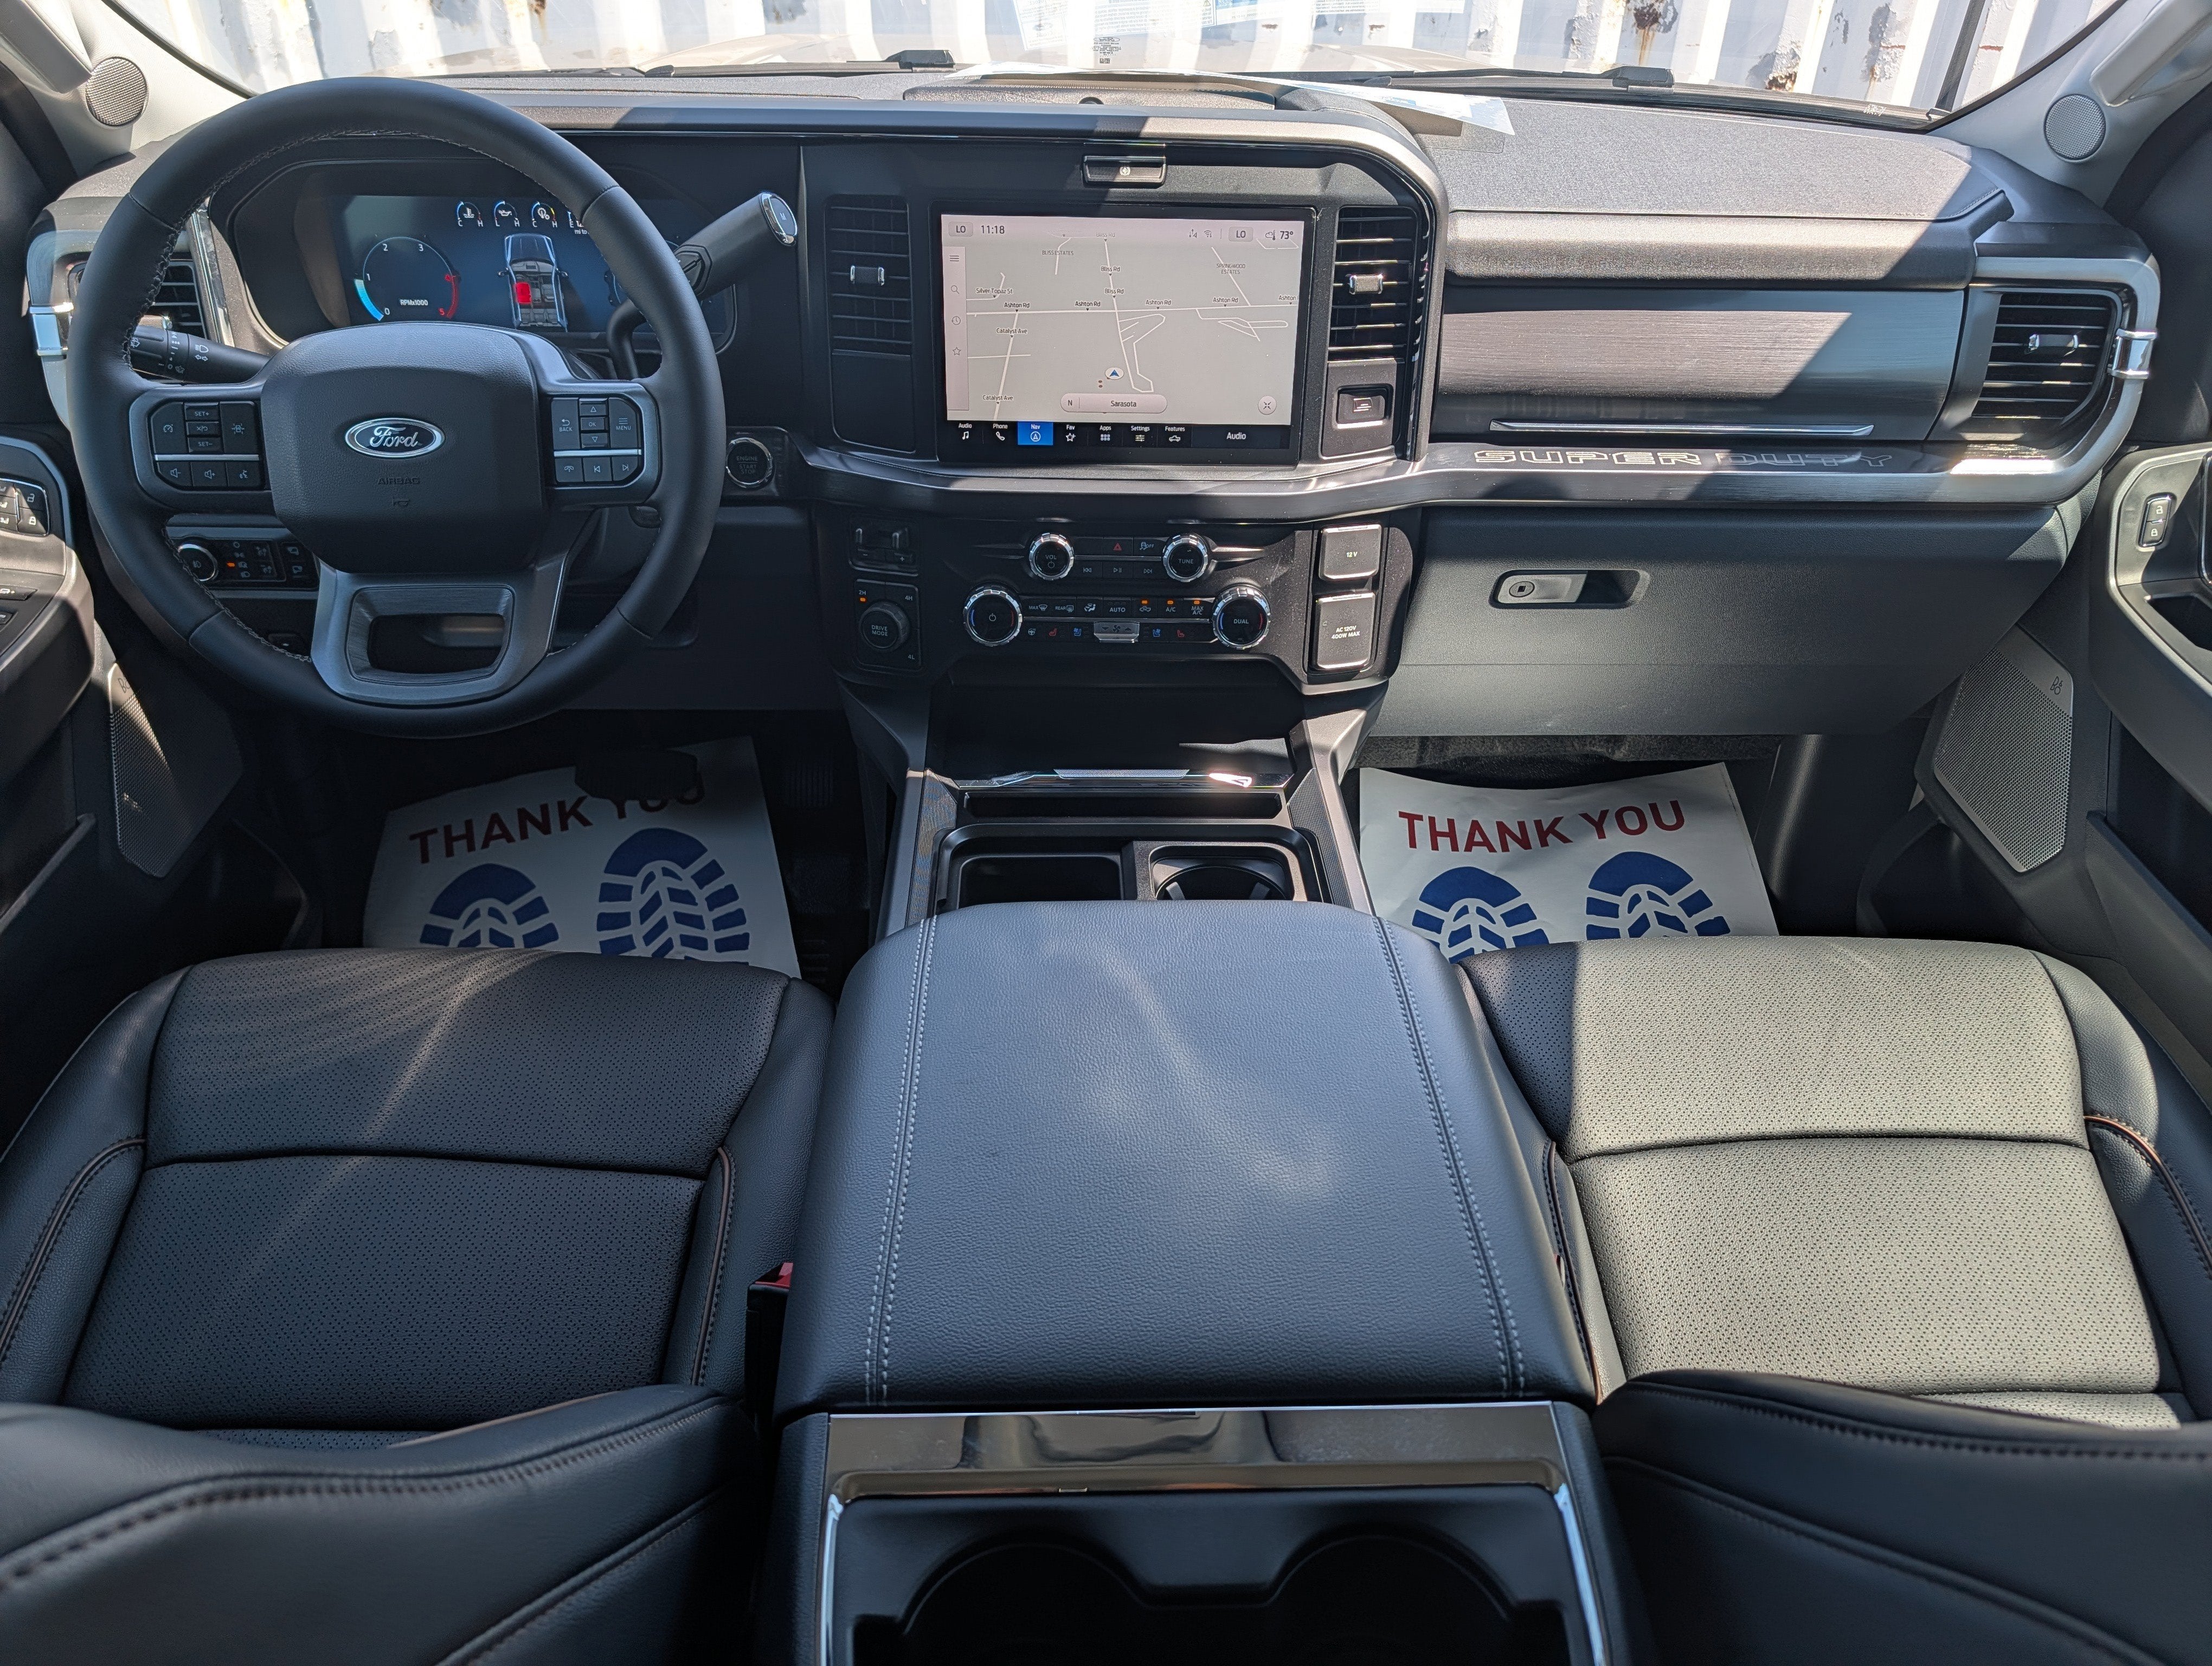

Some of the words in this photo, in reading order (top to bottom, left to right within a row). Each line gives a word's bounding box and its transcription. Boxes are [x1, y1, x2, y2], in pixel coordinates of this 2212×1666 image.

[981, 225, 1005, 234] 11:18
[383, 244, 388, 252] 2
[419, 244, 424, 252] 3
[439, 307, 445, 316] 5
[1110, 400, 1137, 408] Sarasota
[370, 426, 419, 448] Ford
[1474, 450, 1702, 465] SUPER
[1715, 452, 1893, 467] DUTY
[377, 477, 421, 486] AIRBAG
[409, 794, 592, 864] THANK
[1399, 811, 1573, 853] THANK
[1579, 800, 1685, 840] YOU
